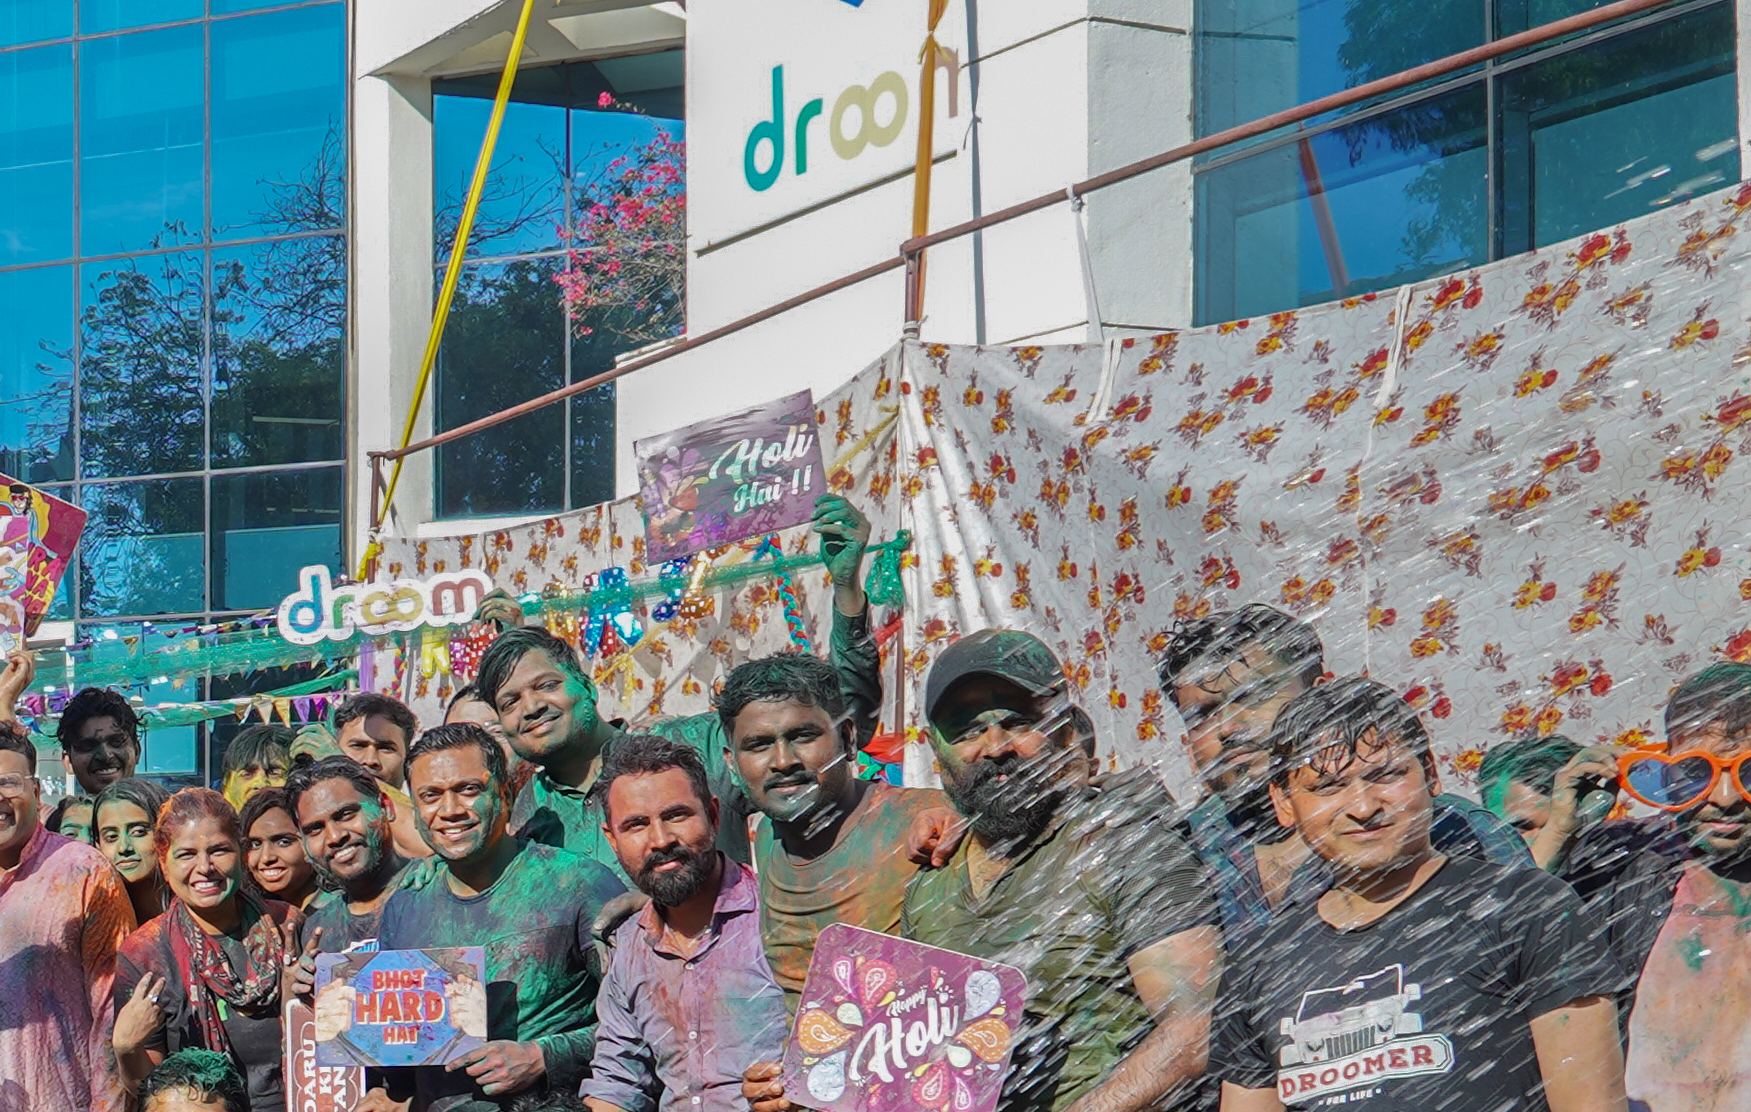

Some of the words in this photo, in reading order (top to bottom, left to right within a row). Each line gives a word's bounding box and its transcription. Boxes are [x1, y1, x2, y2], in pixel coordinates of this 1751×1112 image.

[708, 423, 813, 484] Holi
[734, 476, 783, 513] Hai
[288, 573, 486, 634] droom
[372, 968, 428, 992] BHOT
[355, 990, 446, 1025] HARD
[886, 984, 928, 1017] Happy
[382, 1025, 421, 1045] HAT
[848, 991, 959, 1083] Holi
[1281, 1045, 1435, 1098] DROOMER
